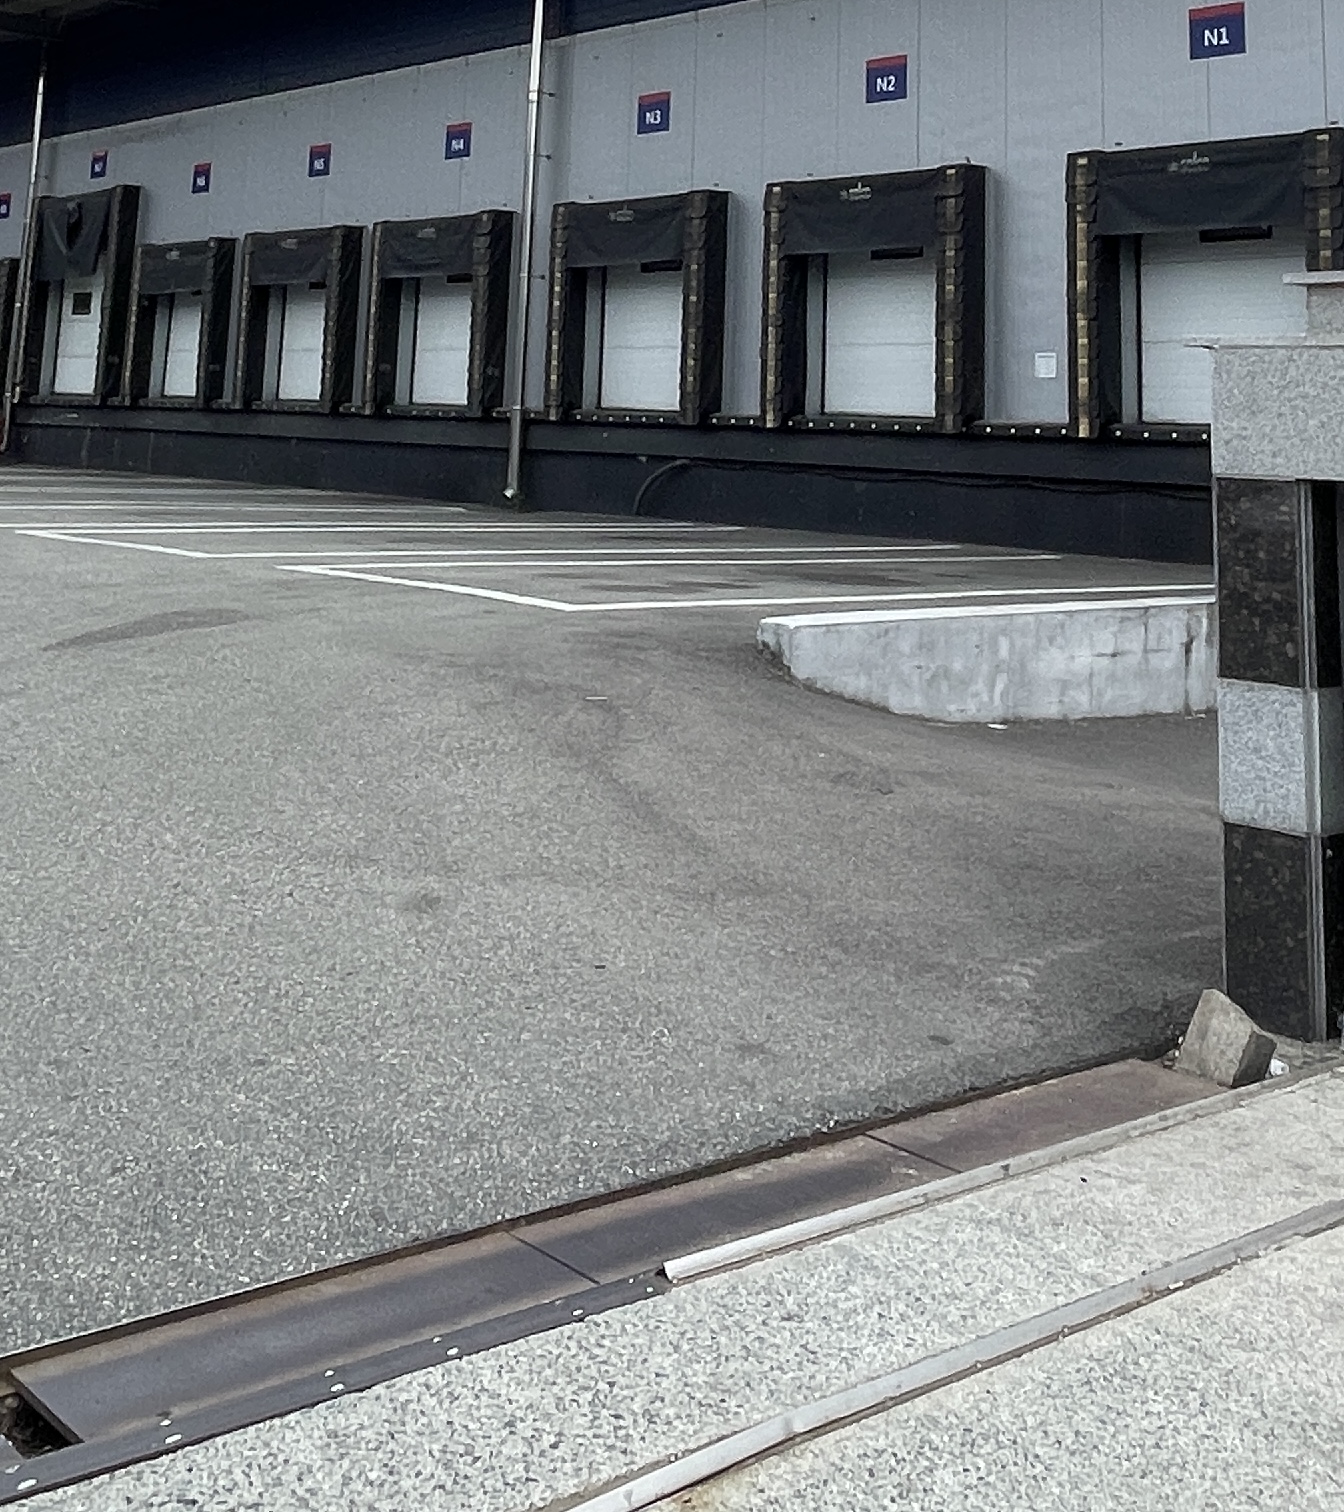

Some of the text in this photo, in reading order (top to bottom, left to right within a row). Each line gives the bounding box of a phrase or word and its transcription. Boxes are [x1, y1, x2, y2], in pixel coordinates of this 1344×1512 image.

[1203, 26, 1230, 47] N1
[876, 75, 896, 93] N2
[645, 109, 662, 125] N3
